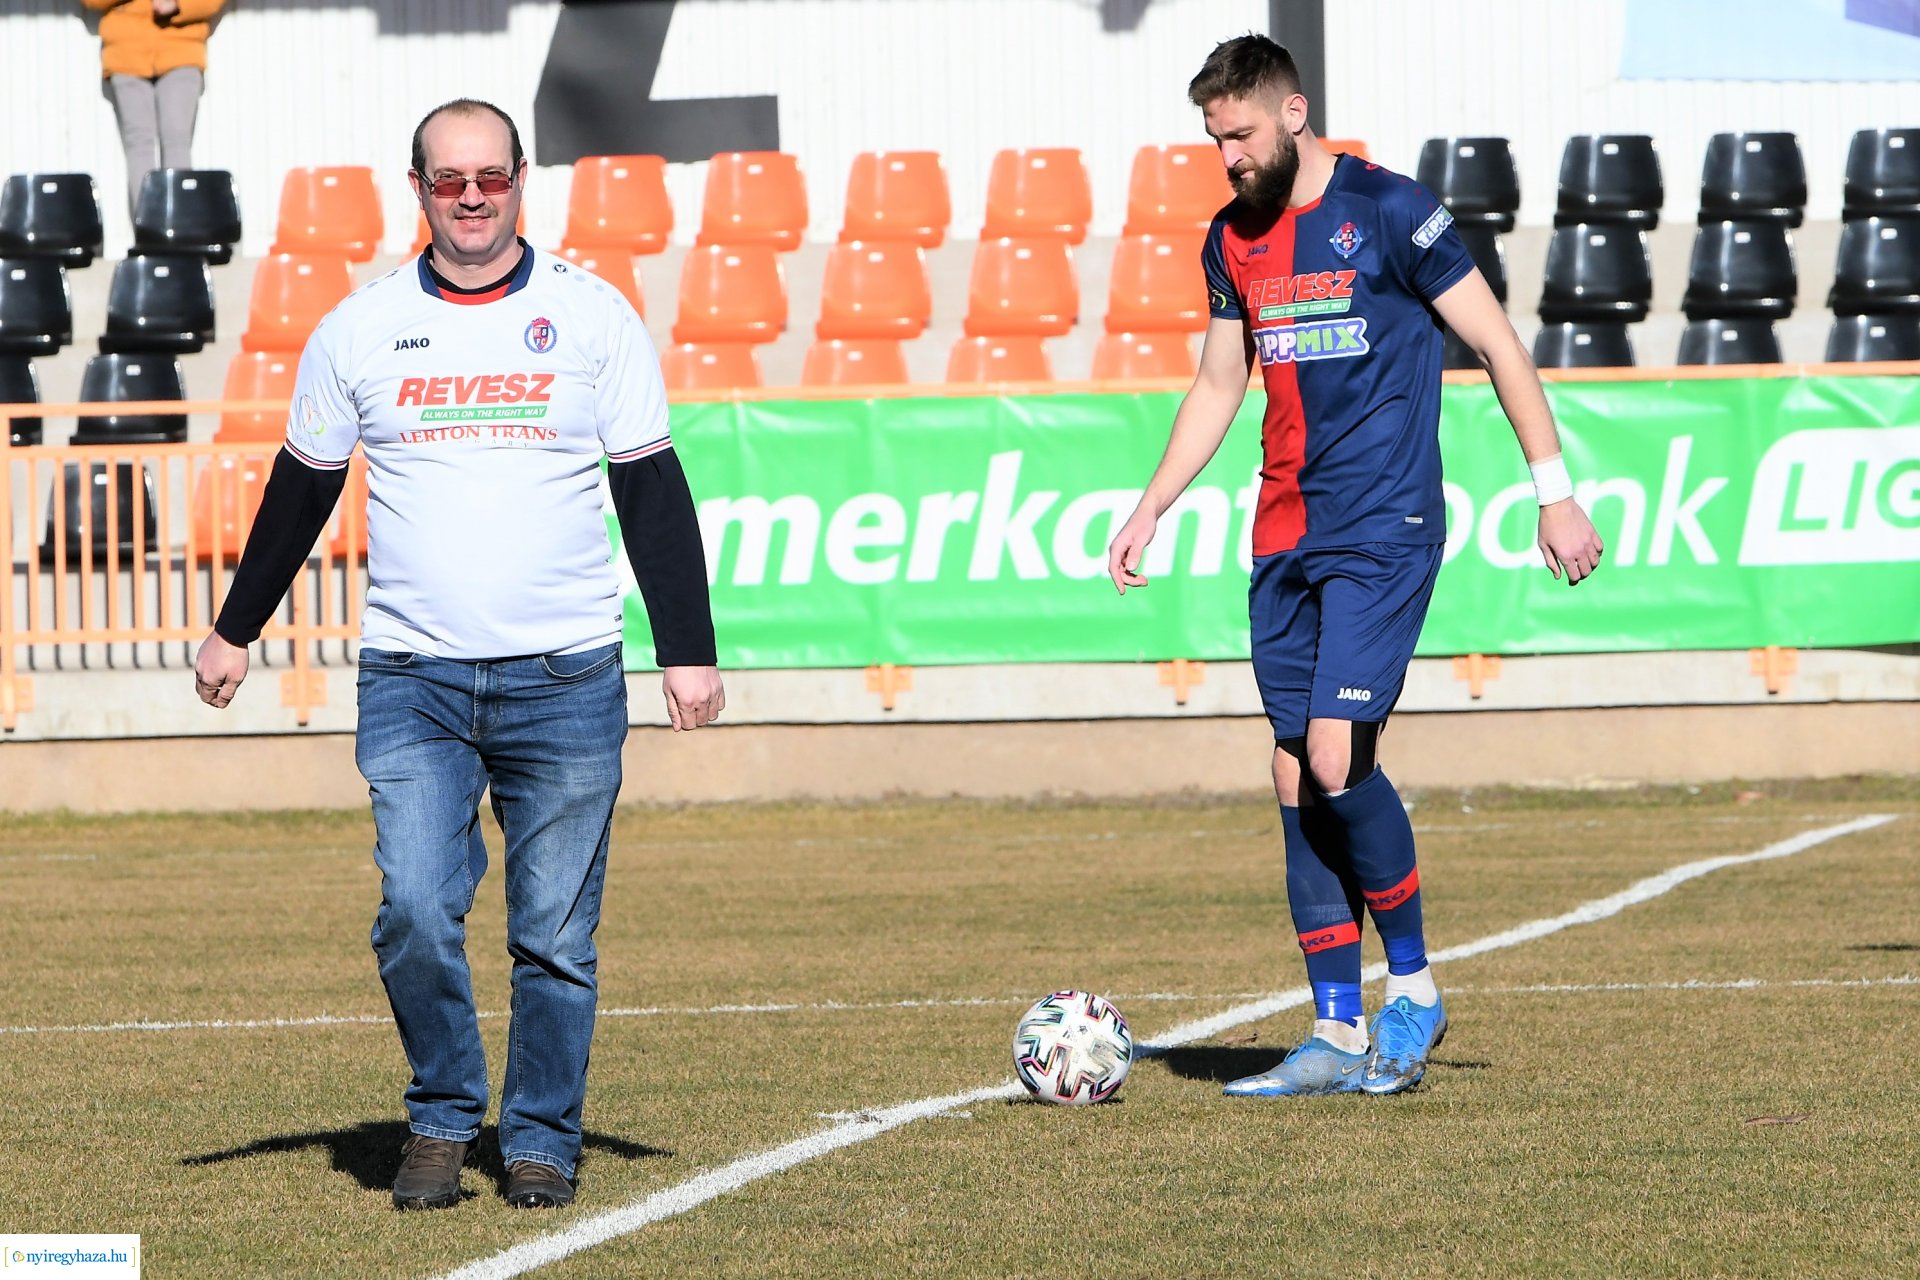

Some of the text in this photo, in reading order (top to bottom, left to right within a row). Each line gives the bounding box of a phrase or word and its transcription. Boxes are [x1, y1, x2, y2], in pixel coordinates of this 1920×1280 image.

[1261, 301, 1349, 318] ALWAYS ON THE RIGHT WAY
[394, 337, 431, 351] JAKO
[422, 407, 546, 420] ALWAYS ON THE RIGHT WAY
[399, 426, 481, 444] LERTON
[487, 425, 558, 442] TRANS
[1336, 687, 1372, 702] JAKO
